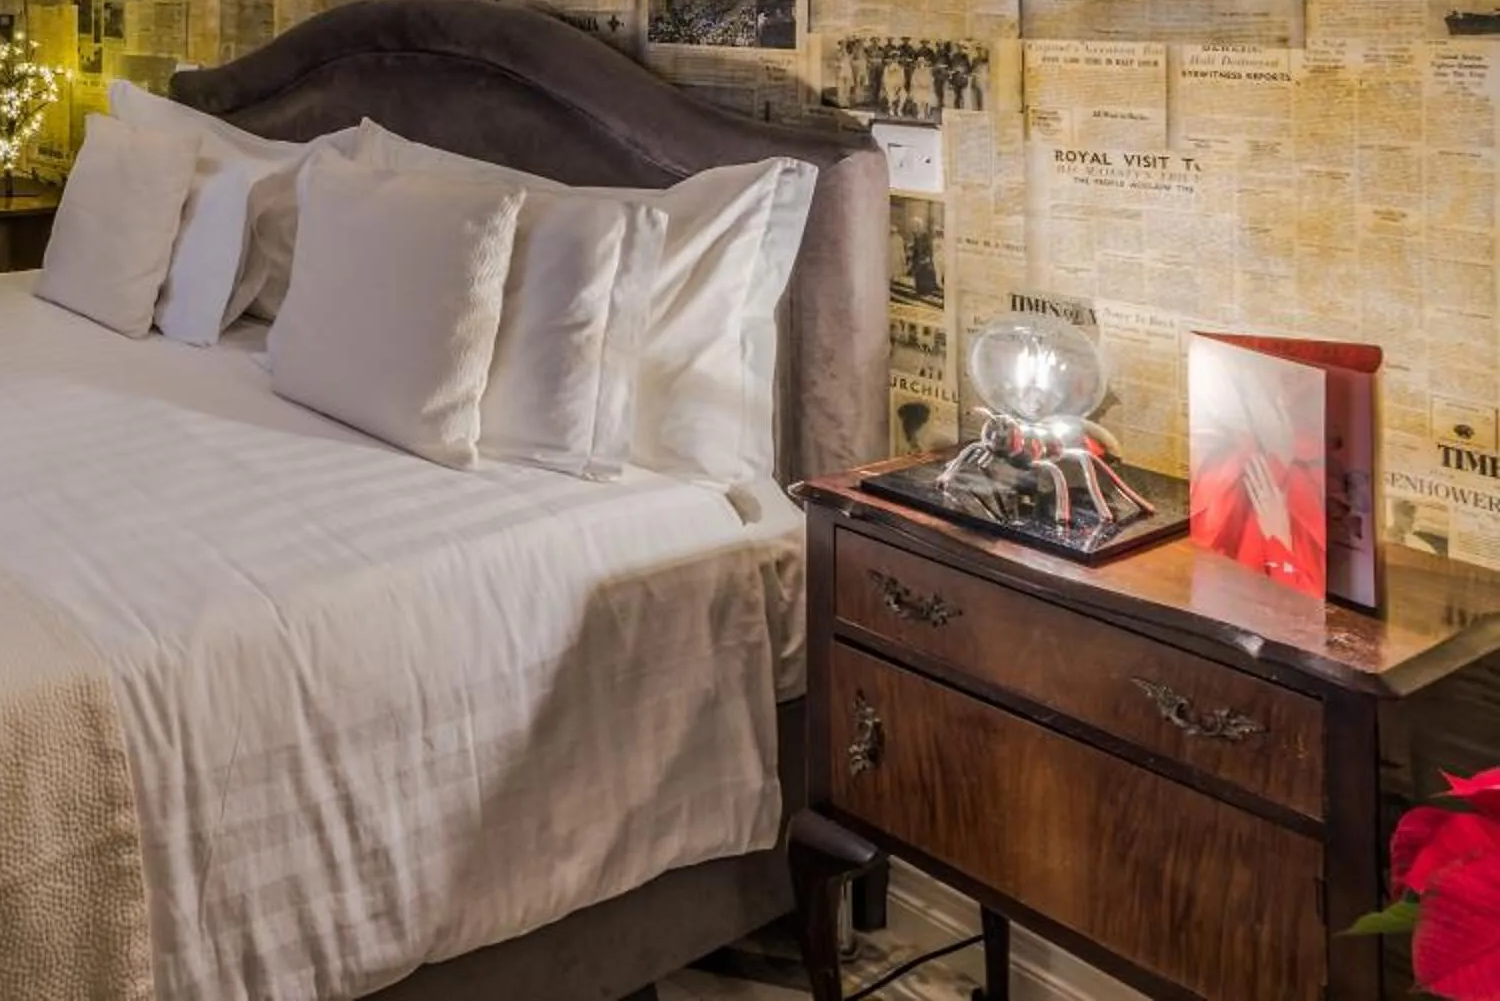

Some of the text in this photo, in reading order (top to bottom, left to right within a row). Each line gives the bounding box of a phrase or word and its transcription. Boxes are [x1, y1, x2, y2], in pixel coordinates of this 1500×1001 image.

[1054, 149, 1113, 167] ROYAL
[1123, 153, 1170, 170] VISIT
[1009, 293, 1062, 318] TIMES
